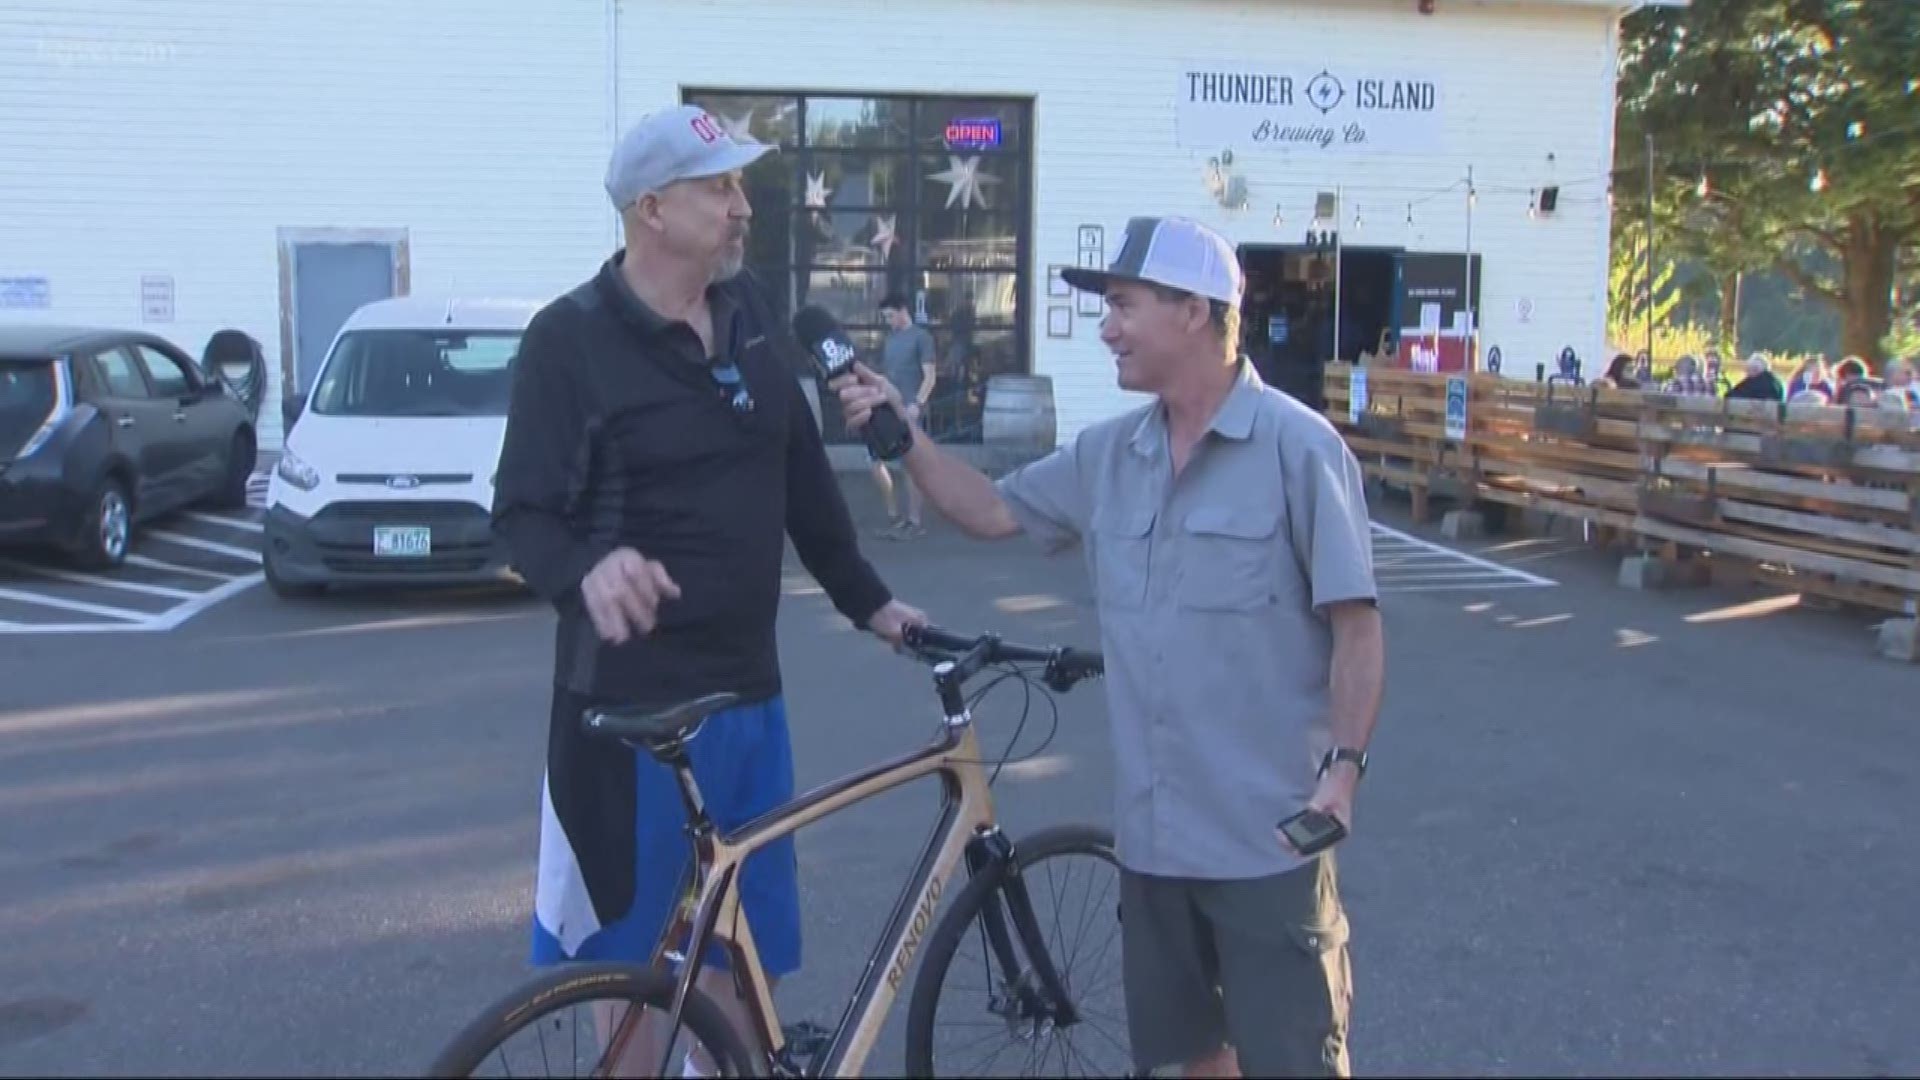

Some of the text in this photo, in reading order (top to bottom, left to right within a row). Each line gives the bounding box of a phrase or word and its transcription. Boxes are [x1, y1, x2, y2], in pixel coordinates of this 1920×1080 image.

[1186, 72, 1435, 112] THUNDER ISLAND
[945, 124, 994, 141] OPEN
[1252, 119, 1369, 149] Brewing Co.
[887, 876, 941, 991] RENOVO
